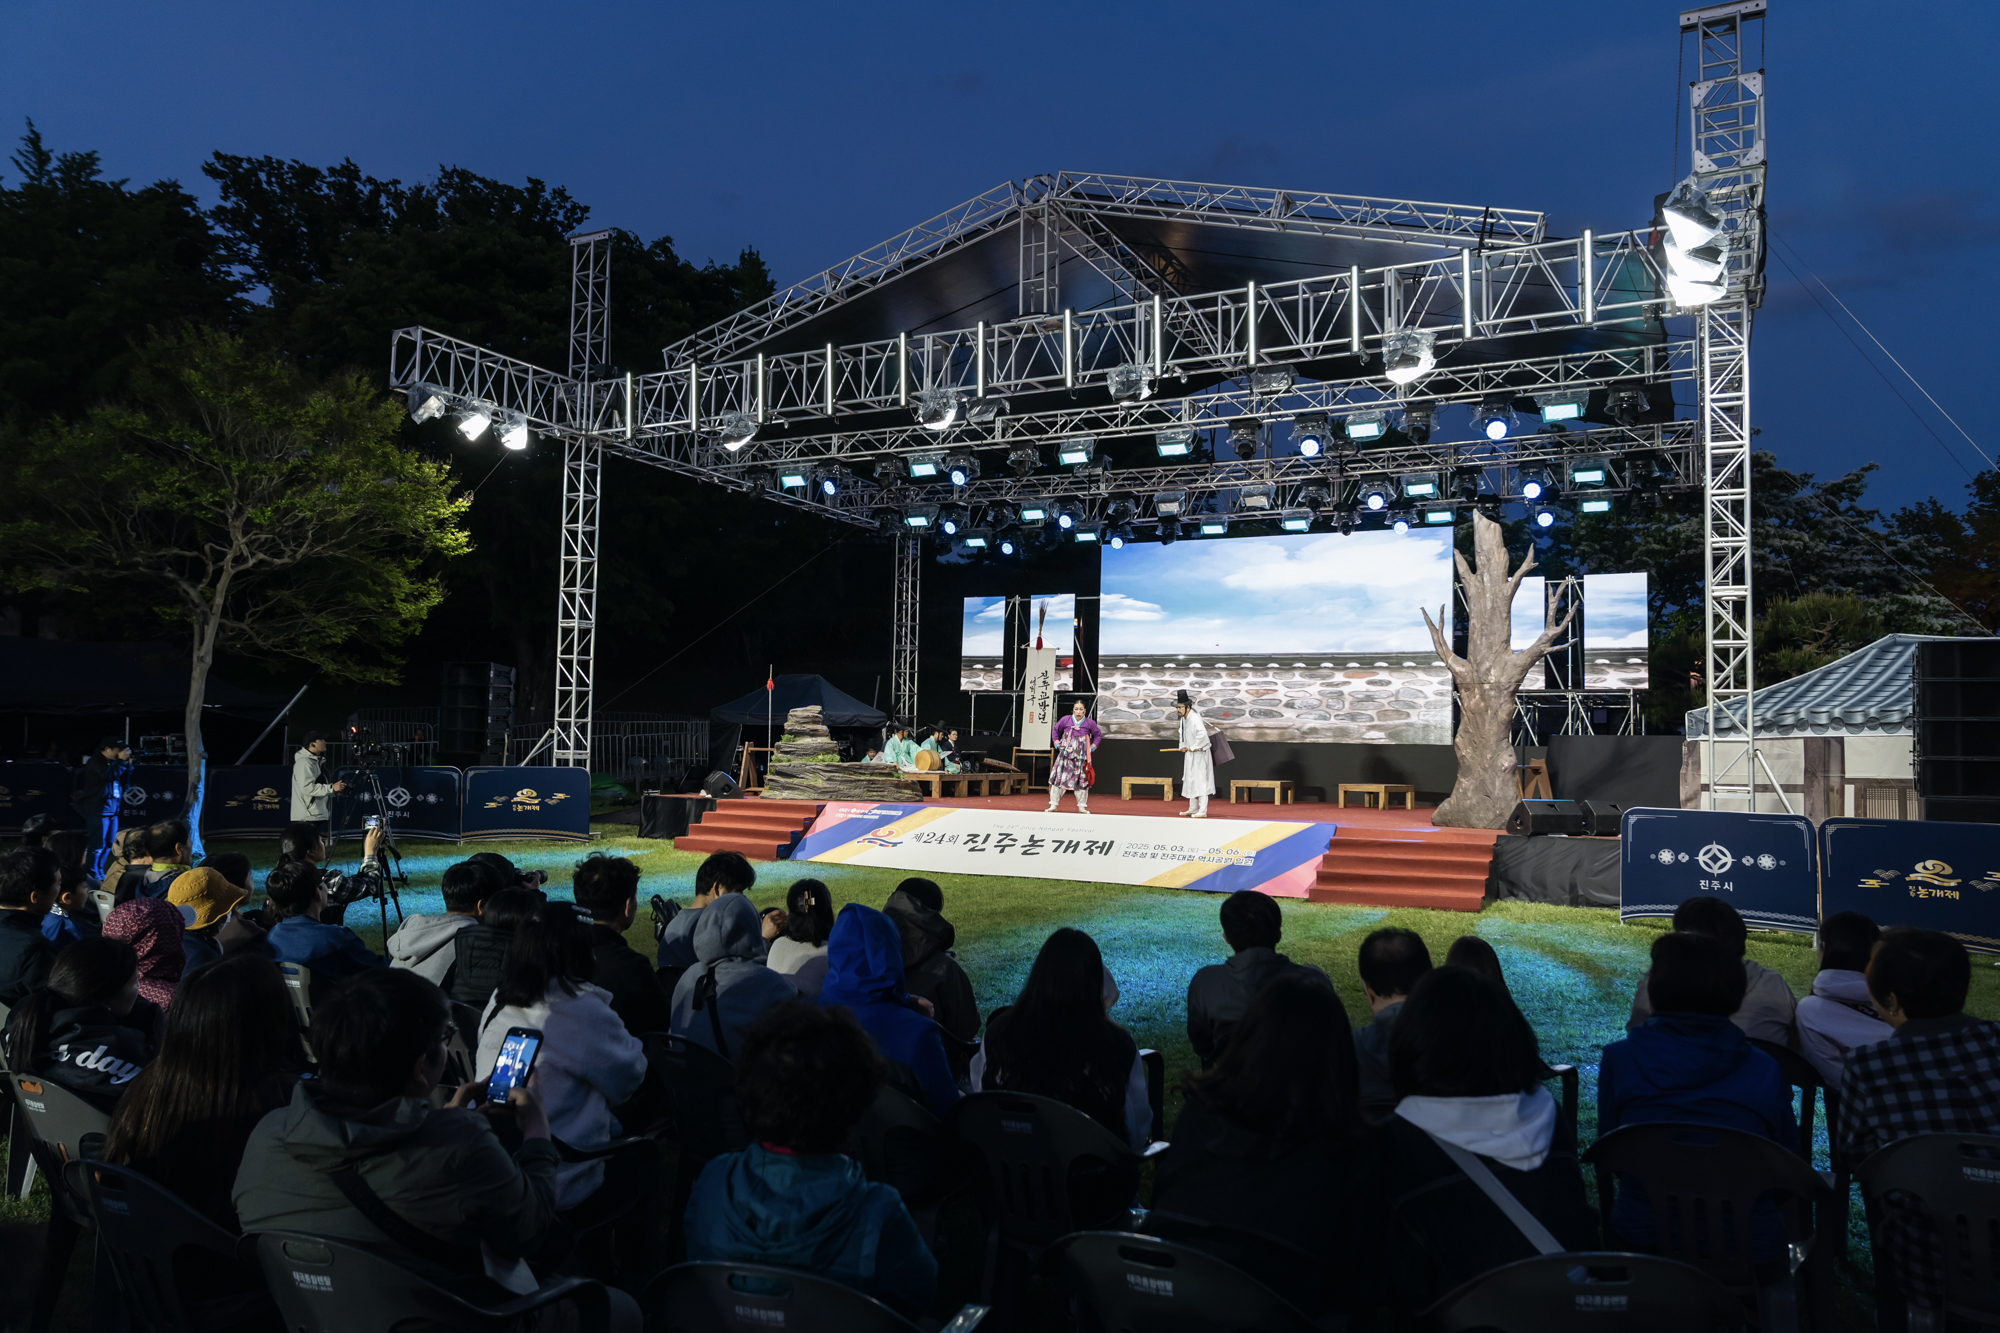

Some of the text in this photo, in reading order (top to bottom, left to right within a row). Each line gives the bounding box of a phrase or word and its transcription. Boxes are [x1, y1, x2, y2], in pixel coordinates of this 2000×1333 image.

[387, 811, 410, 819] 진주시
[1226, 848, 1241, 856] 06.
[1699, 879, 1733, 892] 진주시
[1916, 885, 1960, 900] 논개제
[75, 1044, 142, 1085] day
